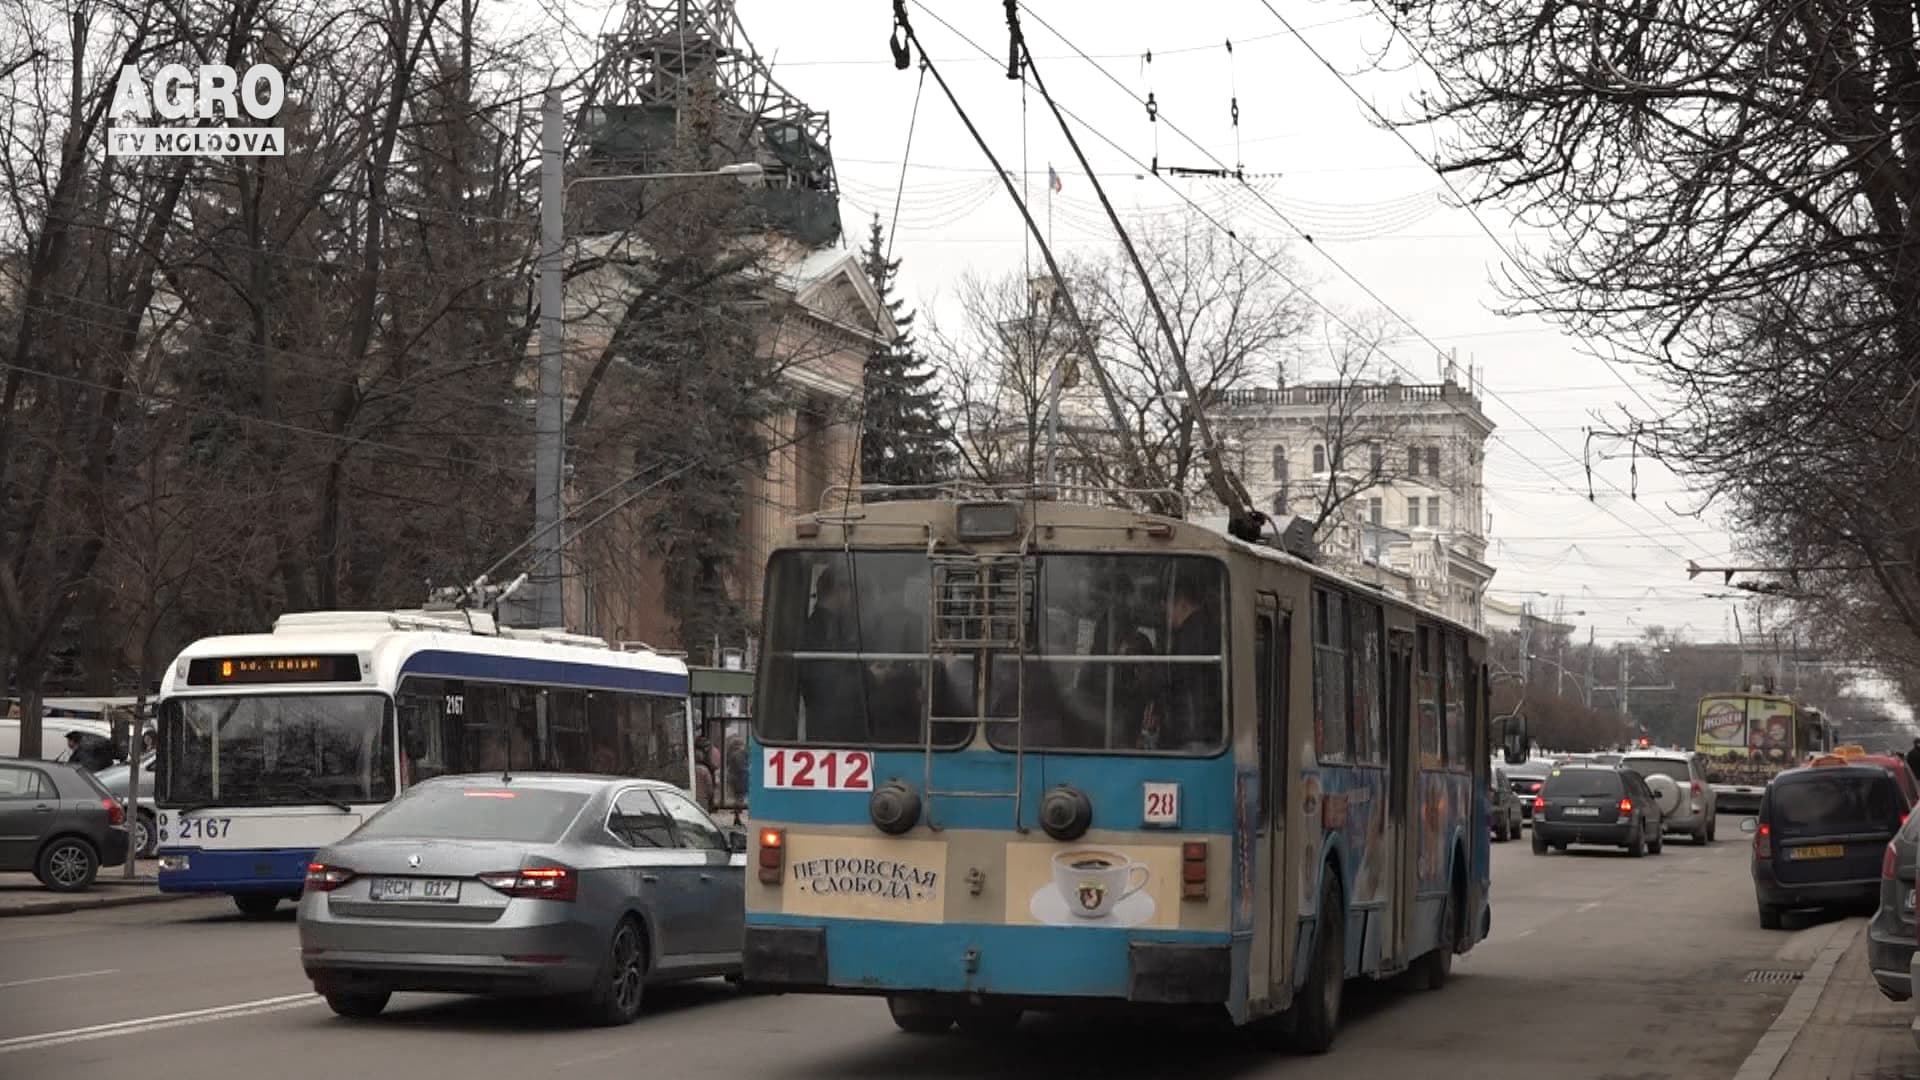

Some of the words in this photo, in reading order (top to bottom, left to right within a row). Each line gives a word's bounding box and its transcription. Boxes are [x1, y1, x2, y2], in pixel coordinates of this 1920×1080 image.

[446, 695, 464, 715] 2167
[769, 751, 869, 788] 1212
[1147, 793, 1174, 816] 28
[180, 819, 231, 838] 2167
[793, 858, 937, 888] ПЕТРОВСКАЯ
[424, 881, 452, 896] 017
[811, 876, 912, 900] СЛОБОДА
